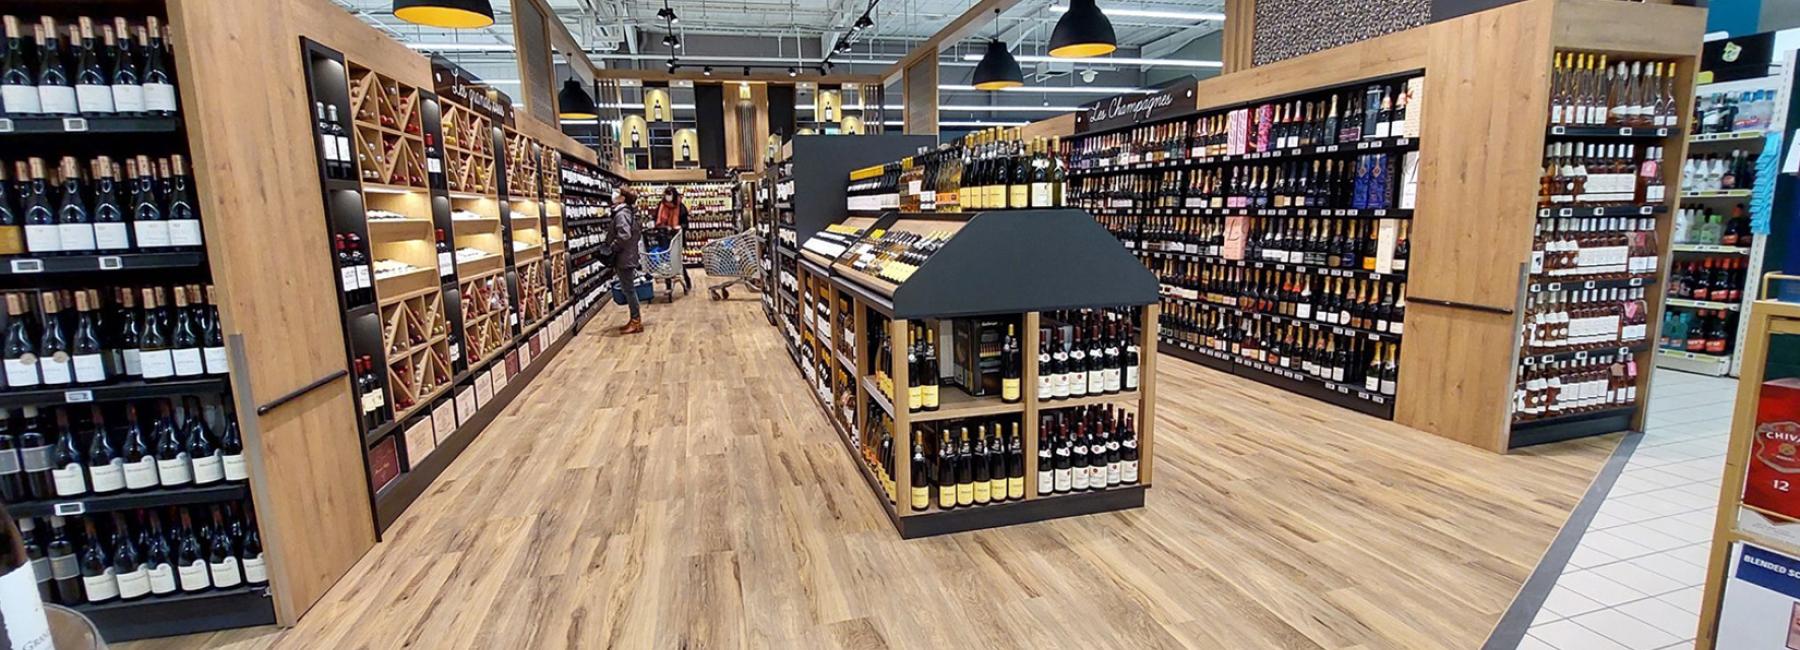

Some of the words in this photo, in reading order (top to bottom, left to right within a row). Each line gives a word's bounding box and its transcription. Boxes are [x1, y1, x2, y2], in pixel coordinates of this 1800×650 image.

[451, 67, 468, 98] Les
[1090, 101, 1107, 122] Les
[1108, 93, 1174, 119] Champagnes
[1773, 479, 1790, 492] 12
[1743, 554, 1787, 575] BLENDED
